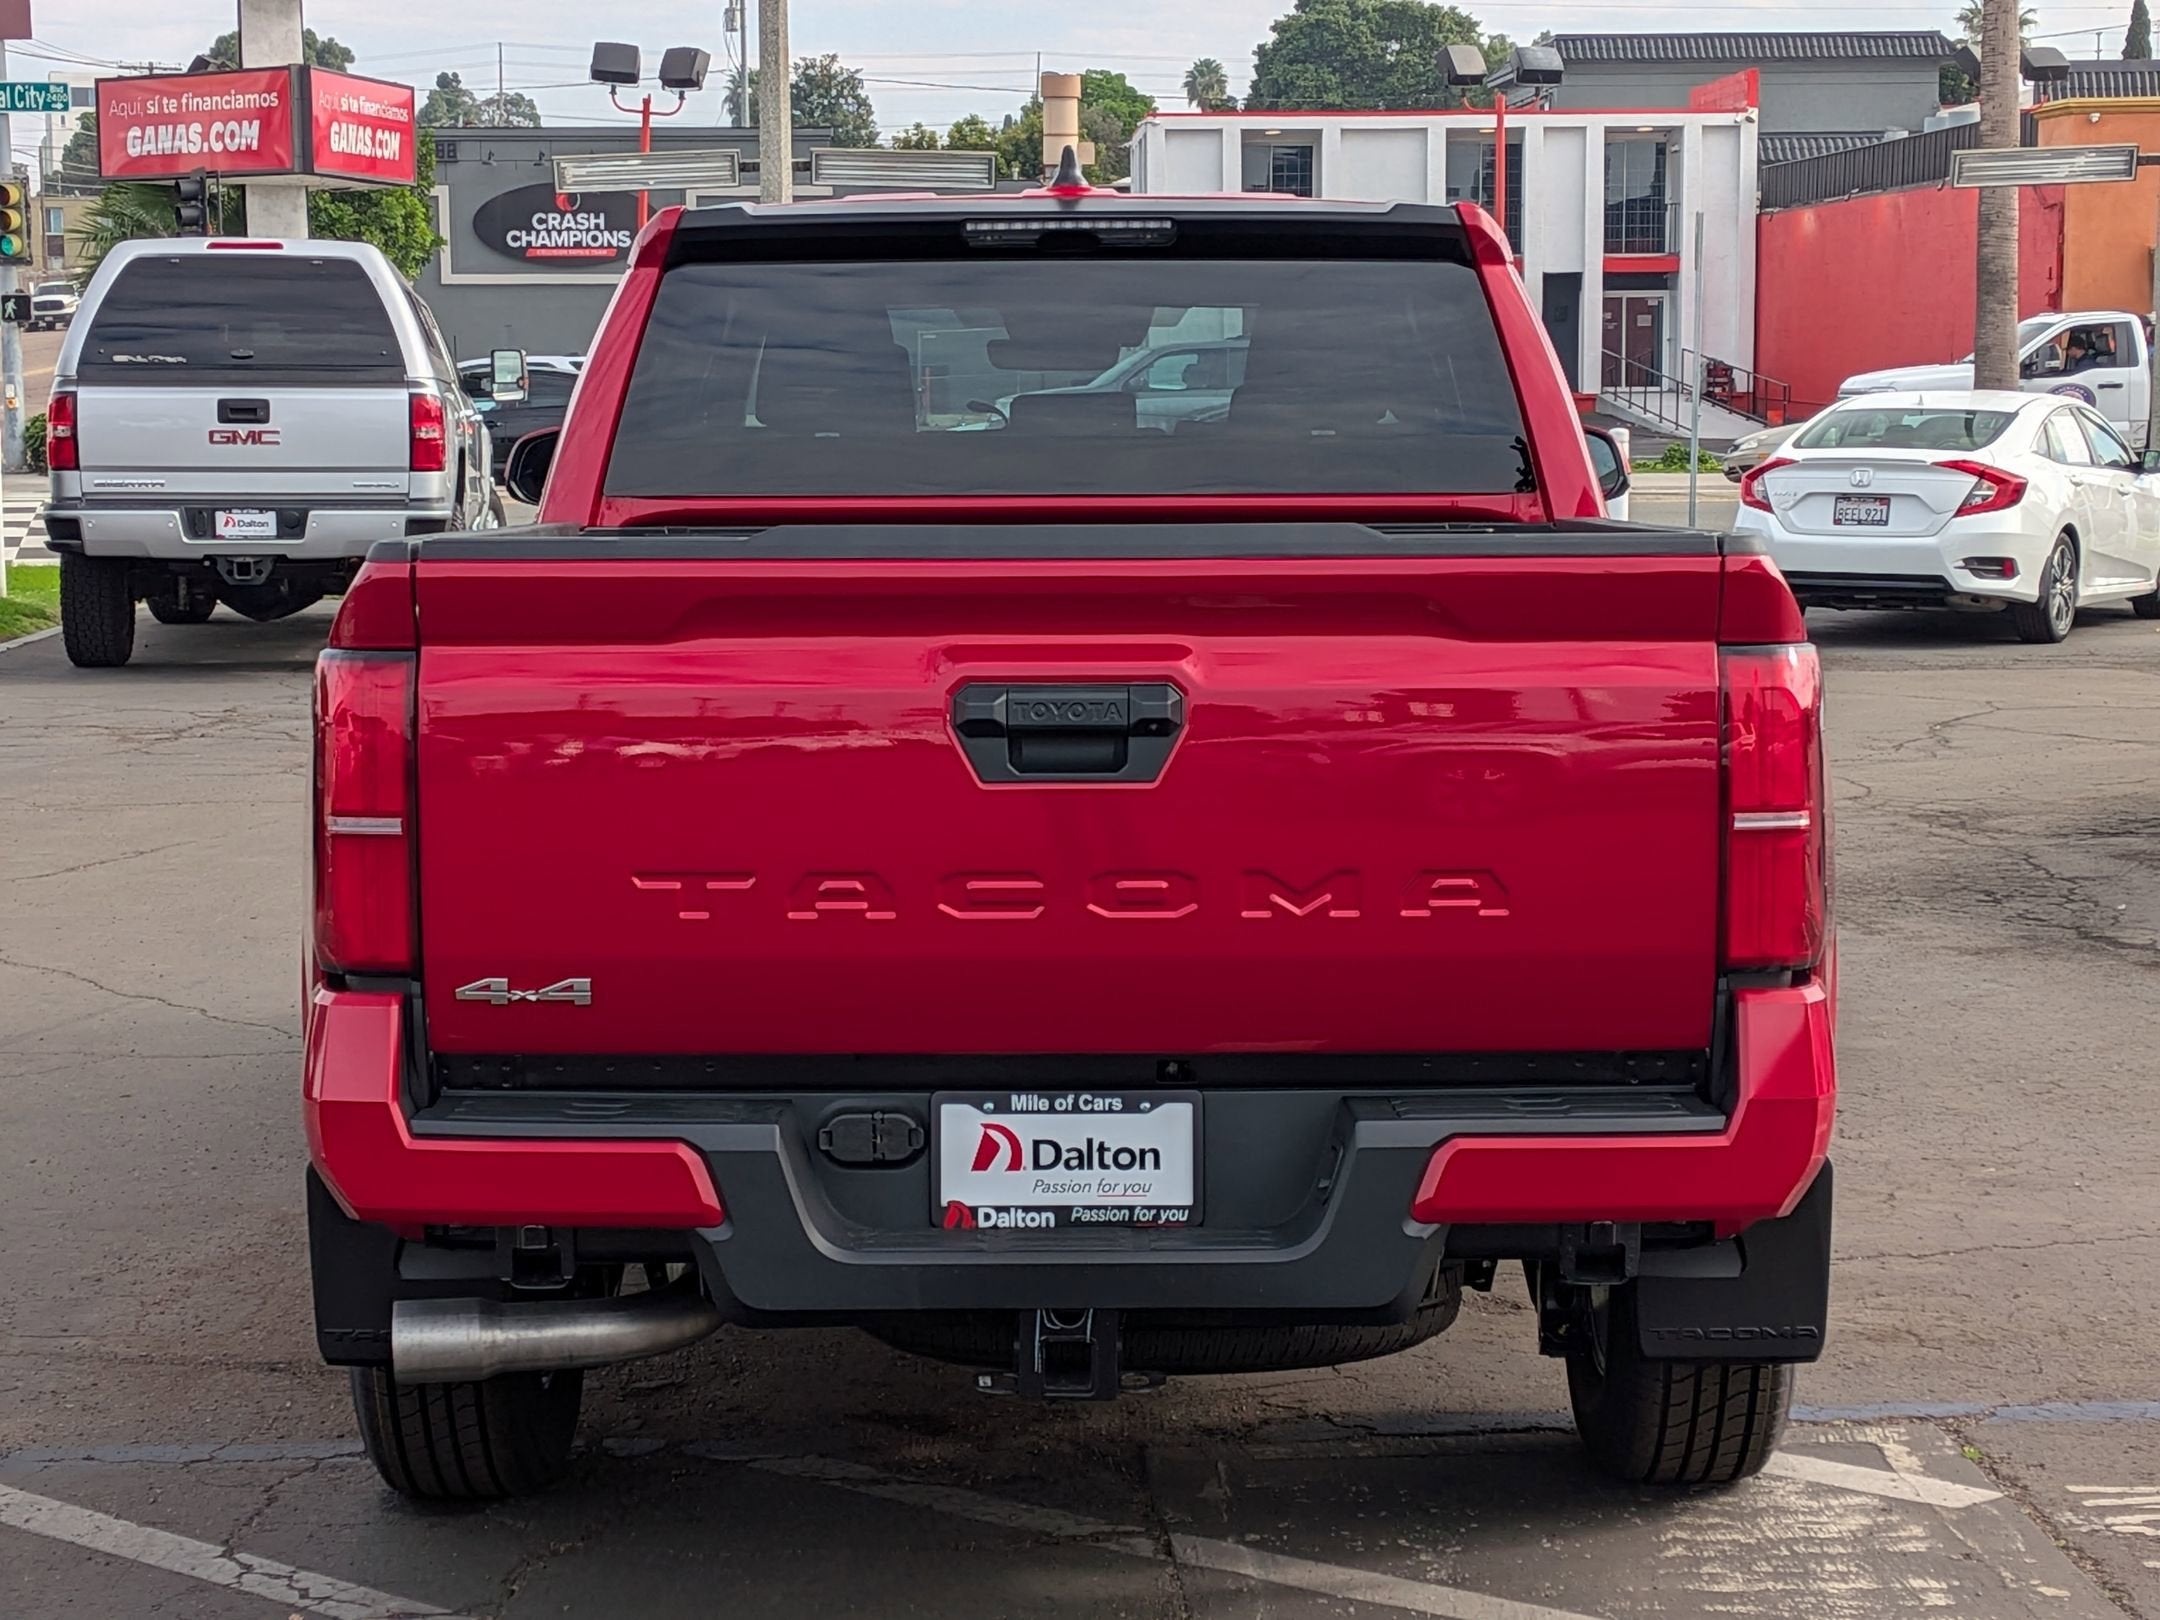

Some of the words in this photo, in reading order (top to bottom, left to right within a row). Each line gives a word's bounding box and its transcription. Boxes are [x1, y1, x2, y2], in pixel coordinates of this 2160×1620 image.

[14, 85, 46, 110] City
[162, 97, 177, 114] te
[180, 89, 279, 113] financiamos
[359, 96, 408, 122] financiamos
[126, 119, 260, 158] GANAS.COM
[331, 121, 400, 160] GANAS.COM
[531, 212, 605, 230] CRASH
[506, 230, 632, 248] CHAMPIONS
[208, 430, 281, 446] GMC
[237, 520, 269, 528] Dalton
[1013, 702, 1123, 722] TOYOTA
[630, 870, 1512, 921] TACOMA
[455, 977, 592, 1005] 4x4
[1011, 1094, 1050, 1111] Mile
[1054, 1094, 1076, 1111] of
[1078, 1094, 1123, 1111] Cars
[1031, 1137, 1161, 1171] Dalton
[1032, 1178, 1092, 1194] Passion
[1095, 1177, 1119, 1194] for
[1121, 1181, 1152, 1197] you
[977, 1207, 1056, 1228] Dalton
[1070, 1206, 1129, 1223] Passion
[1133, 1206, 1157, 1222] for
[1156, 1209, 1189, 1224] you
[1650, 1326, 1819, 1340] TACOMA
